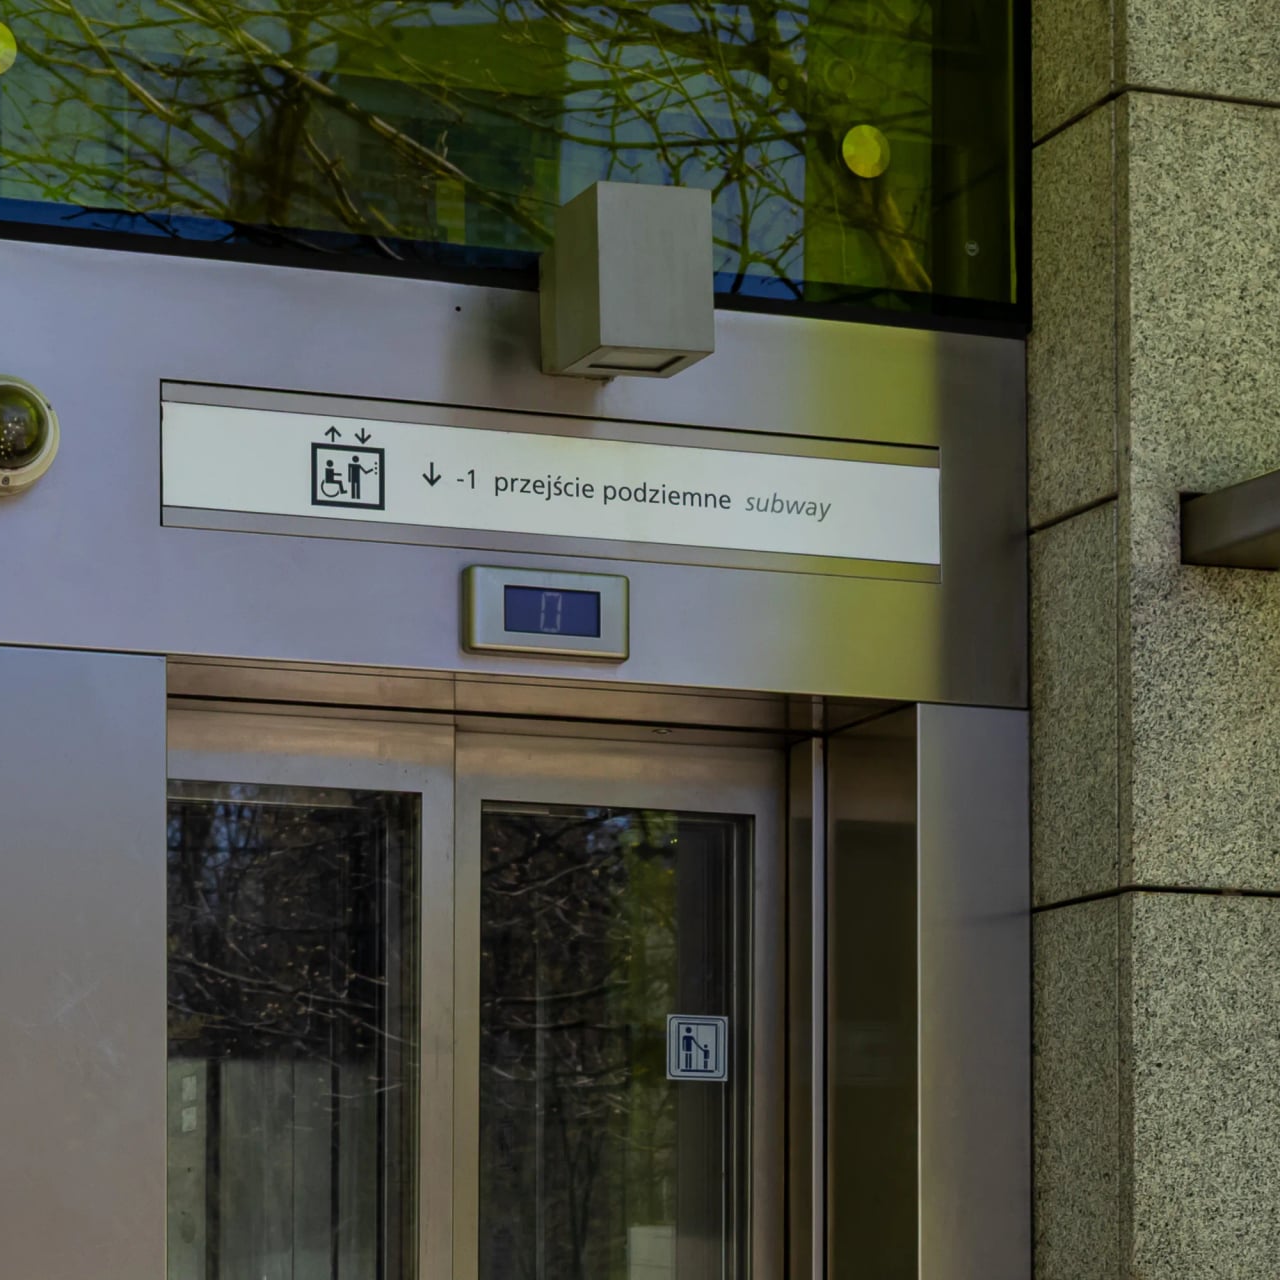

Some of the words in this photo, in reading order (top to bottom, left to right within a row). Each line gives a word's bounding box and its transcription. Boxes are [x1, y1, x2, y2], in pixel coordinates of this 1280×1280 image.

[456, 468, 477, 490] -1
[494, 473, 595, 499] przejście
[603, 482, 732, 510] podziemne
[745, 492, 832, 522] subway
[540, 591, 563, 633] 0
